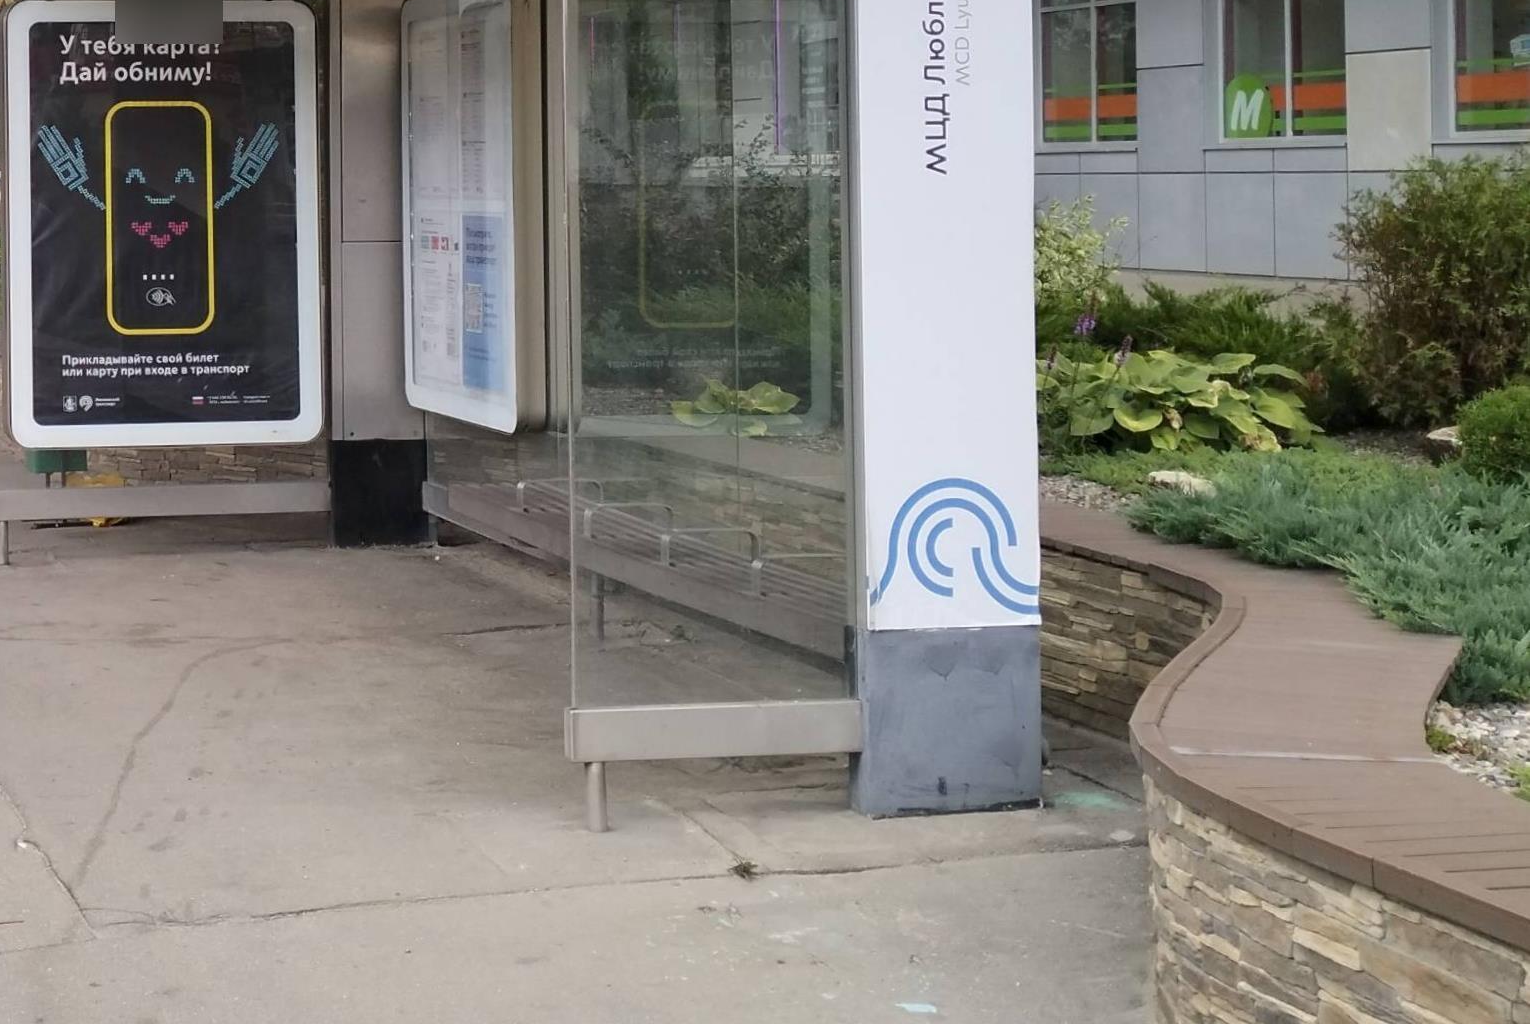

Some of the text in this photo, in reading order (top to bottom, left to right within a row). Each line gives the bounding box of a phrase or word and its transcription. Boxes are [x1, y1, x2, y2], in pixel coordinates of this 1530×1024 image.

[59, 34, 75, 55] У
[81, 35, 135, 55] тебя
[954, 36, 970, 86] MCD
[59, 61, 212, 86] Дай обниму!
[924, 93, 950, 175] МЦД
[62, 352, 219, 367] Прикладывайте свой билет
[62, 365, 250, 378] или карту при входе в транспорт
